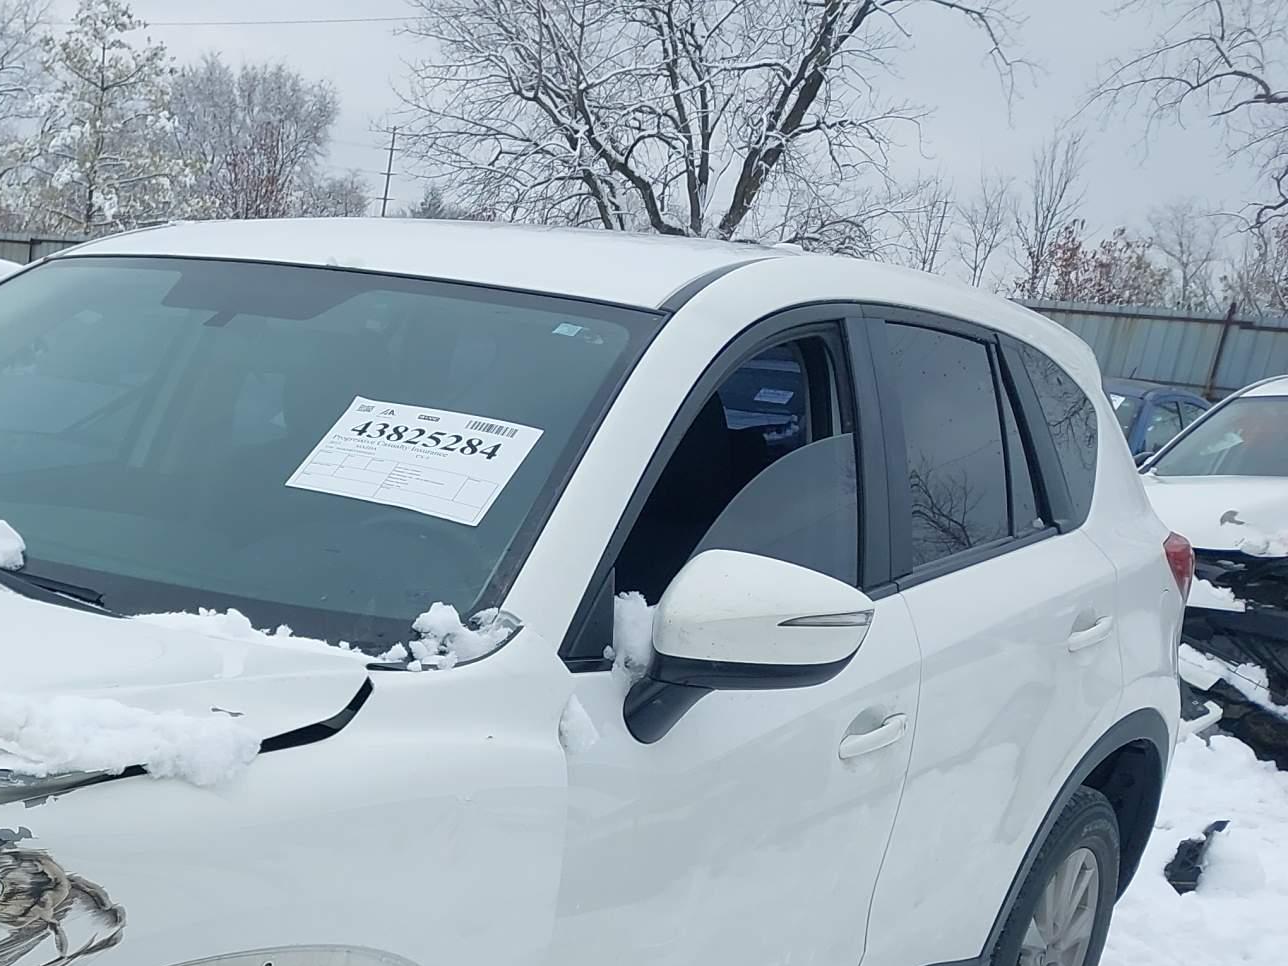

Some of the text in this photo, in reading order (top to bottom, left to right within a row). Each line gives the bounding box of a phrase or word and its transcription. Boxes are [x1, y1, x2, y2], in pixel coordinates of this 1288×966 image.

[332, 434, 376, 445] Progressive
[376, 440, 409, 452] Casualty
[410, 445, 449, 458] Insurance
[351, 420, 503, 460] 43825284
